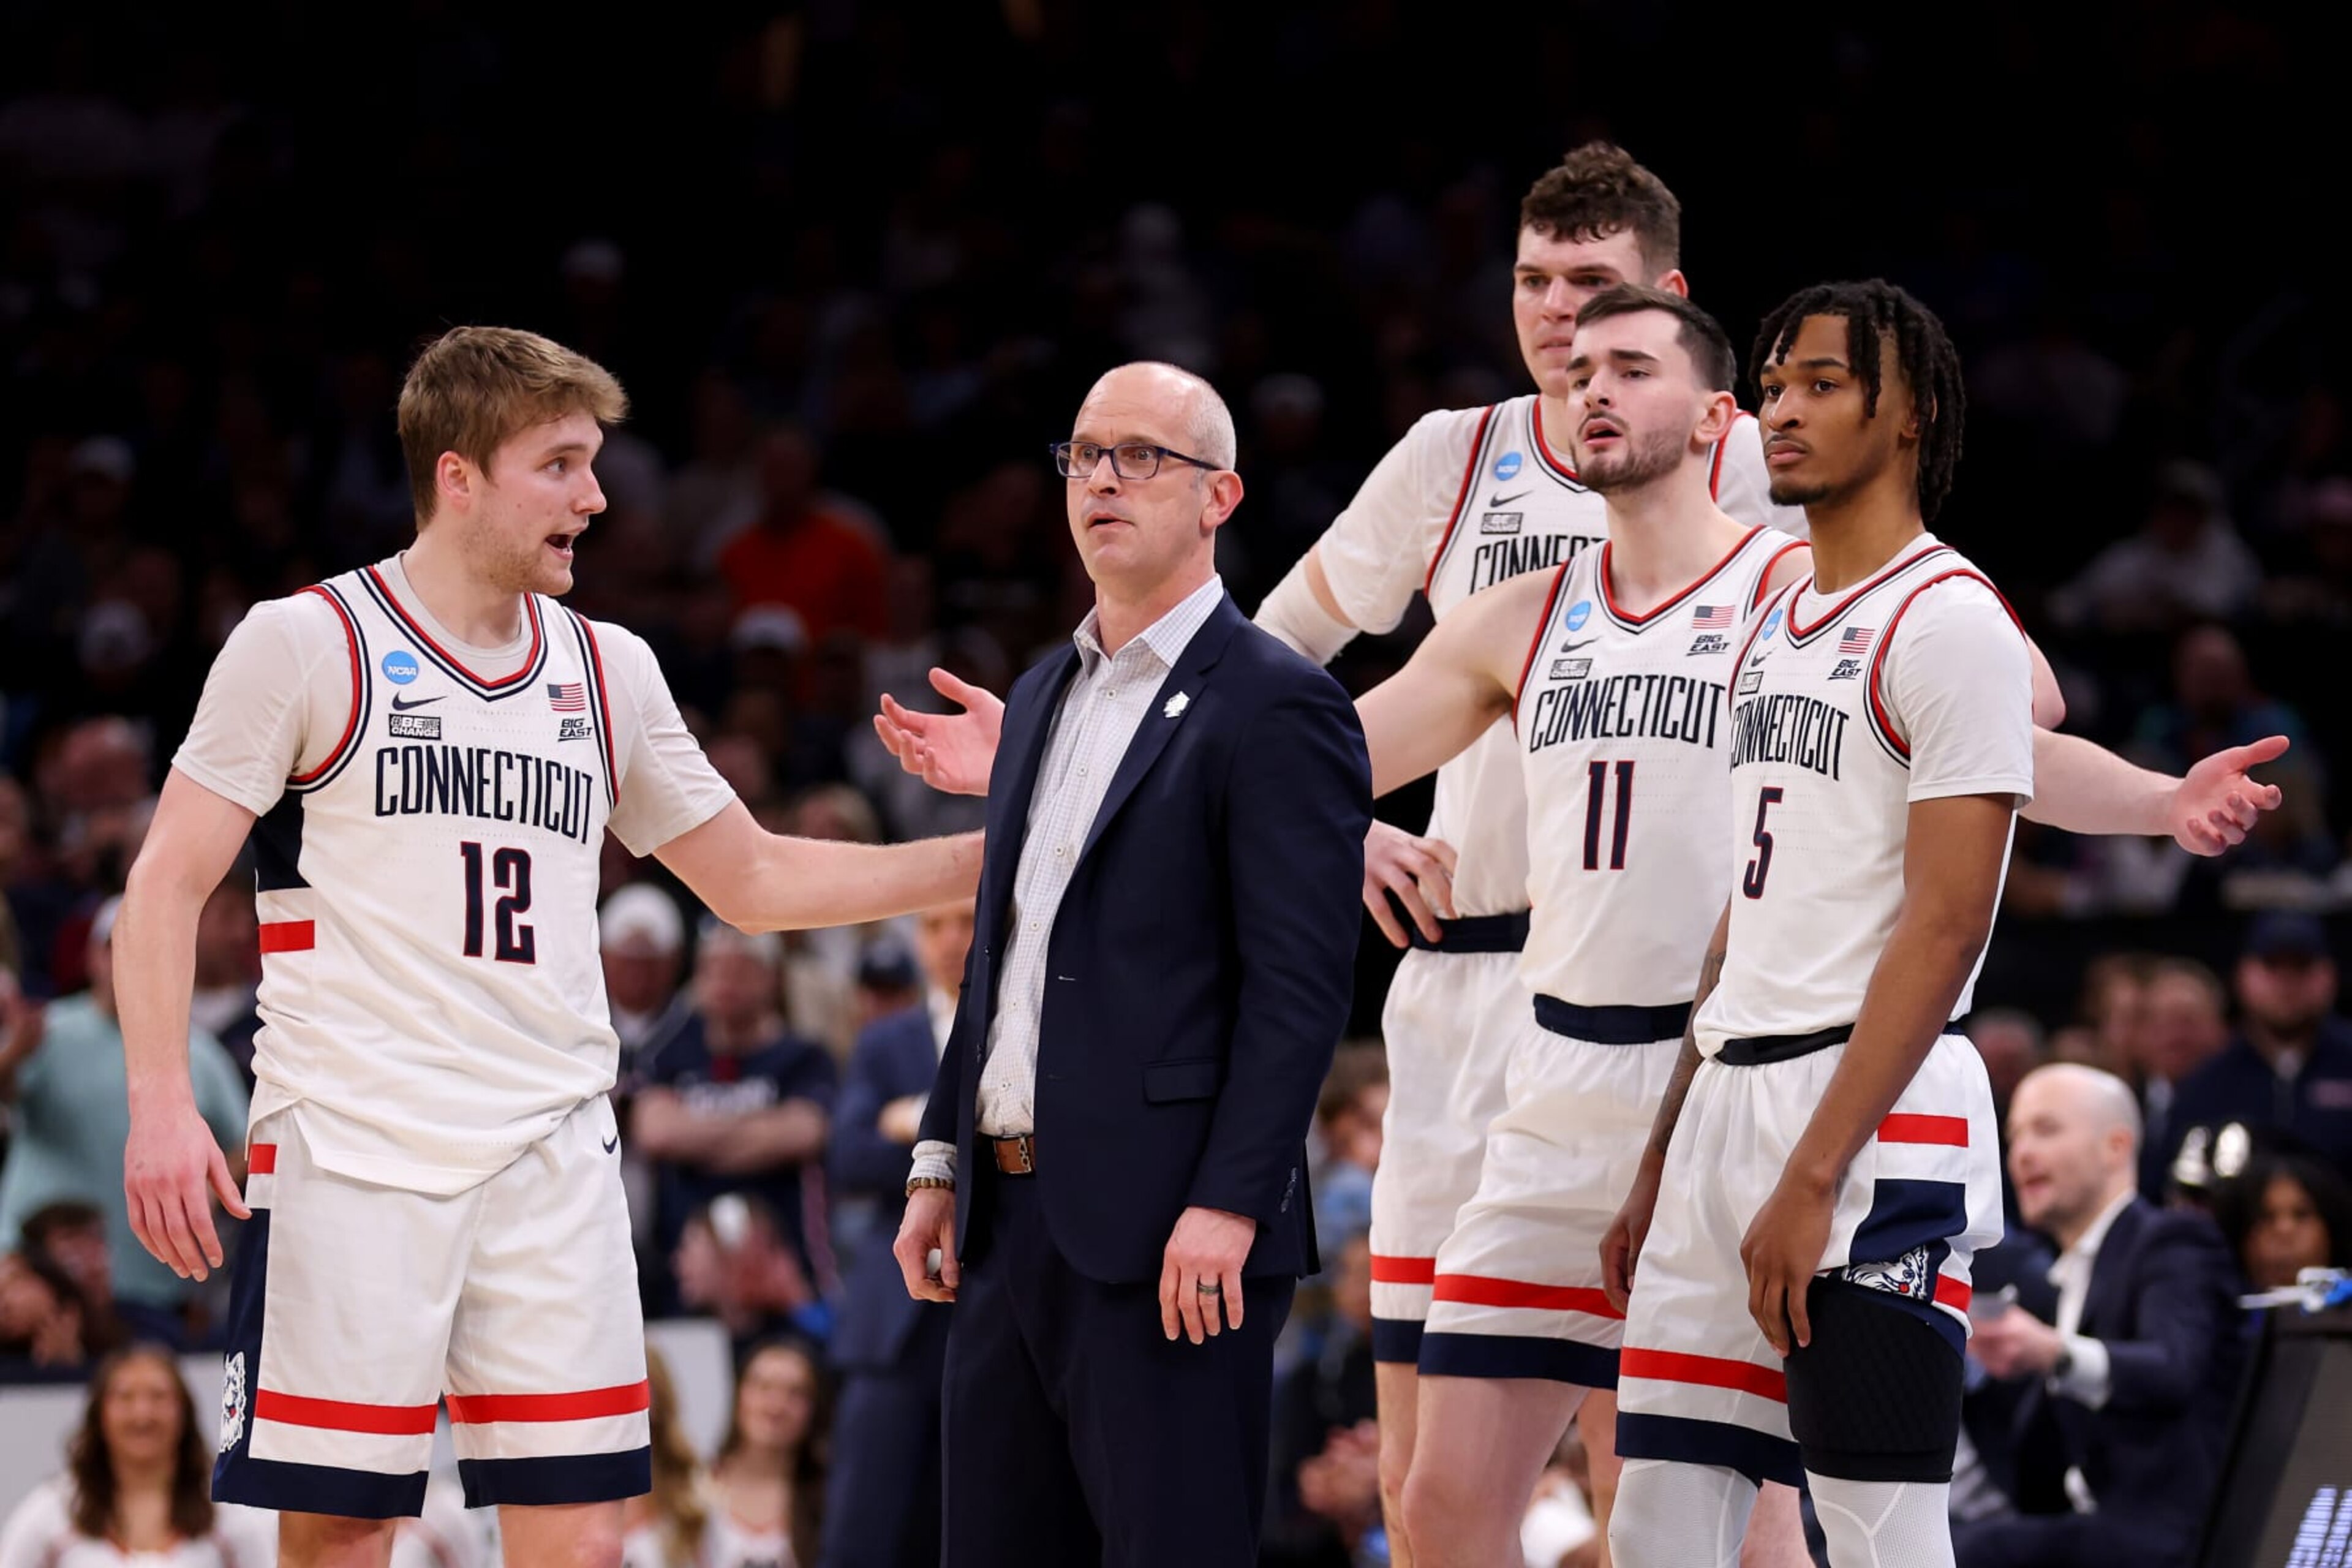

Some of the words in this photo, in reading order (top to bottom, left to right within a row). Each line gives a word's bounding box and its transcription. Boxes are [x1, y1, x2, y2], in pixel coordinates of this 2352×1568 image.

[1469, 534, 1606, 595] CONNE
[387, 666, 417, 676] NCAA
[1690, 642, 1731, 651] EAST
[391, 727, 440, 737] CHANGE
[559, 726, 592, 737] EAST
[561, 718, 585, 728] BIG
[1529, 674, 1726, 753] CONNECTICUT
[1730, 695, 1849, 781] CONNECTICUT
[375, 745, 593, 844] CONNECTICUT
[1583, 760, 1635, 870] 11
[1743, 786, 1784, 899] 5
[460, 841, 536, 965] 12
